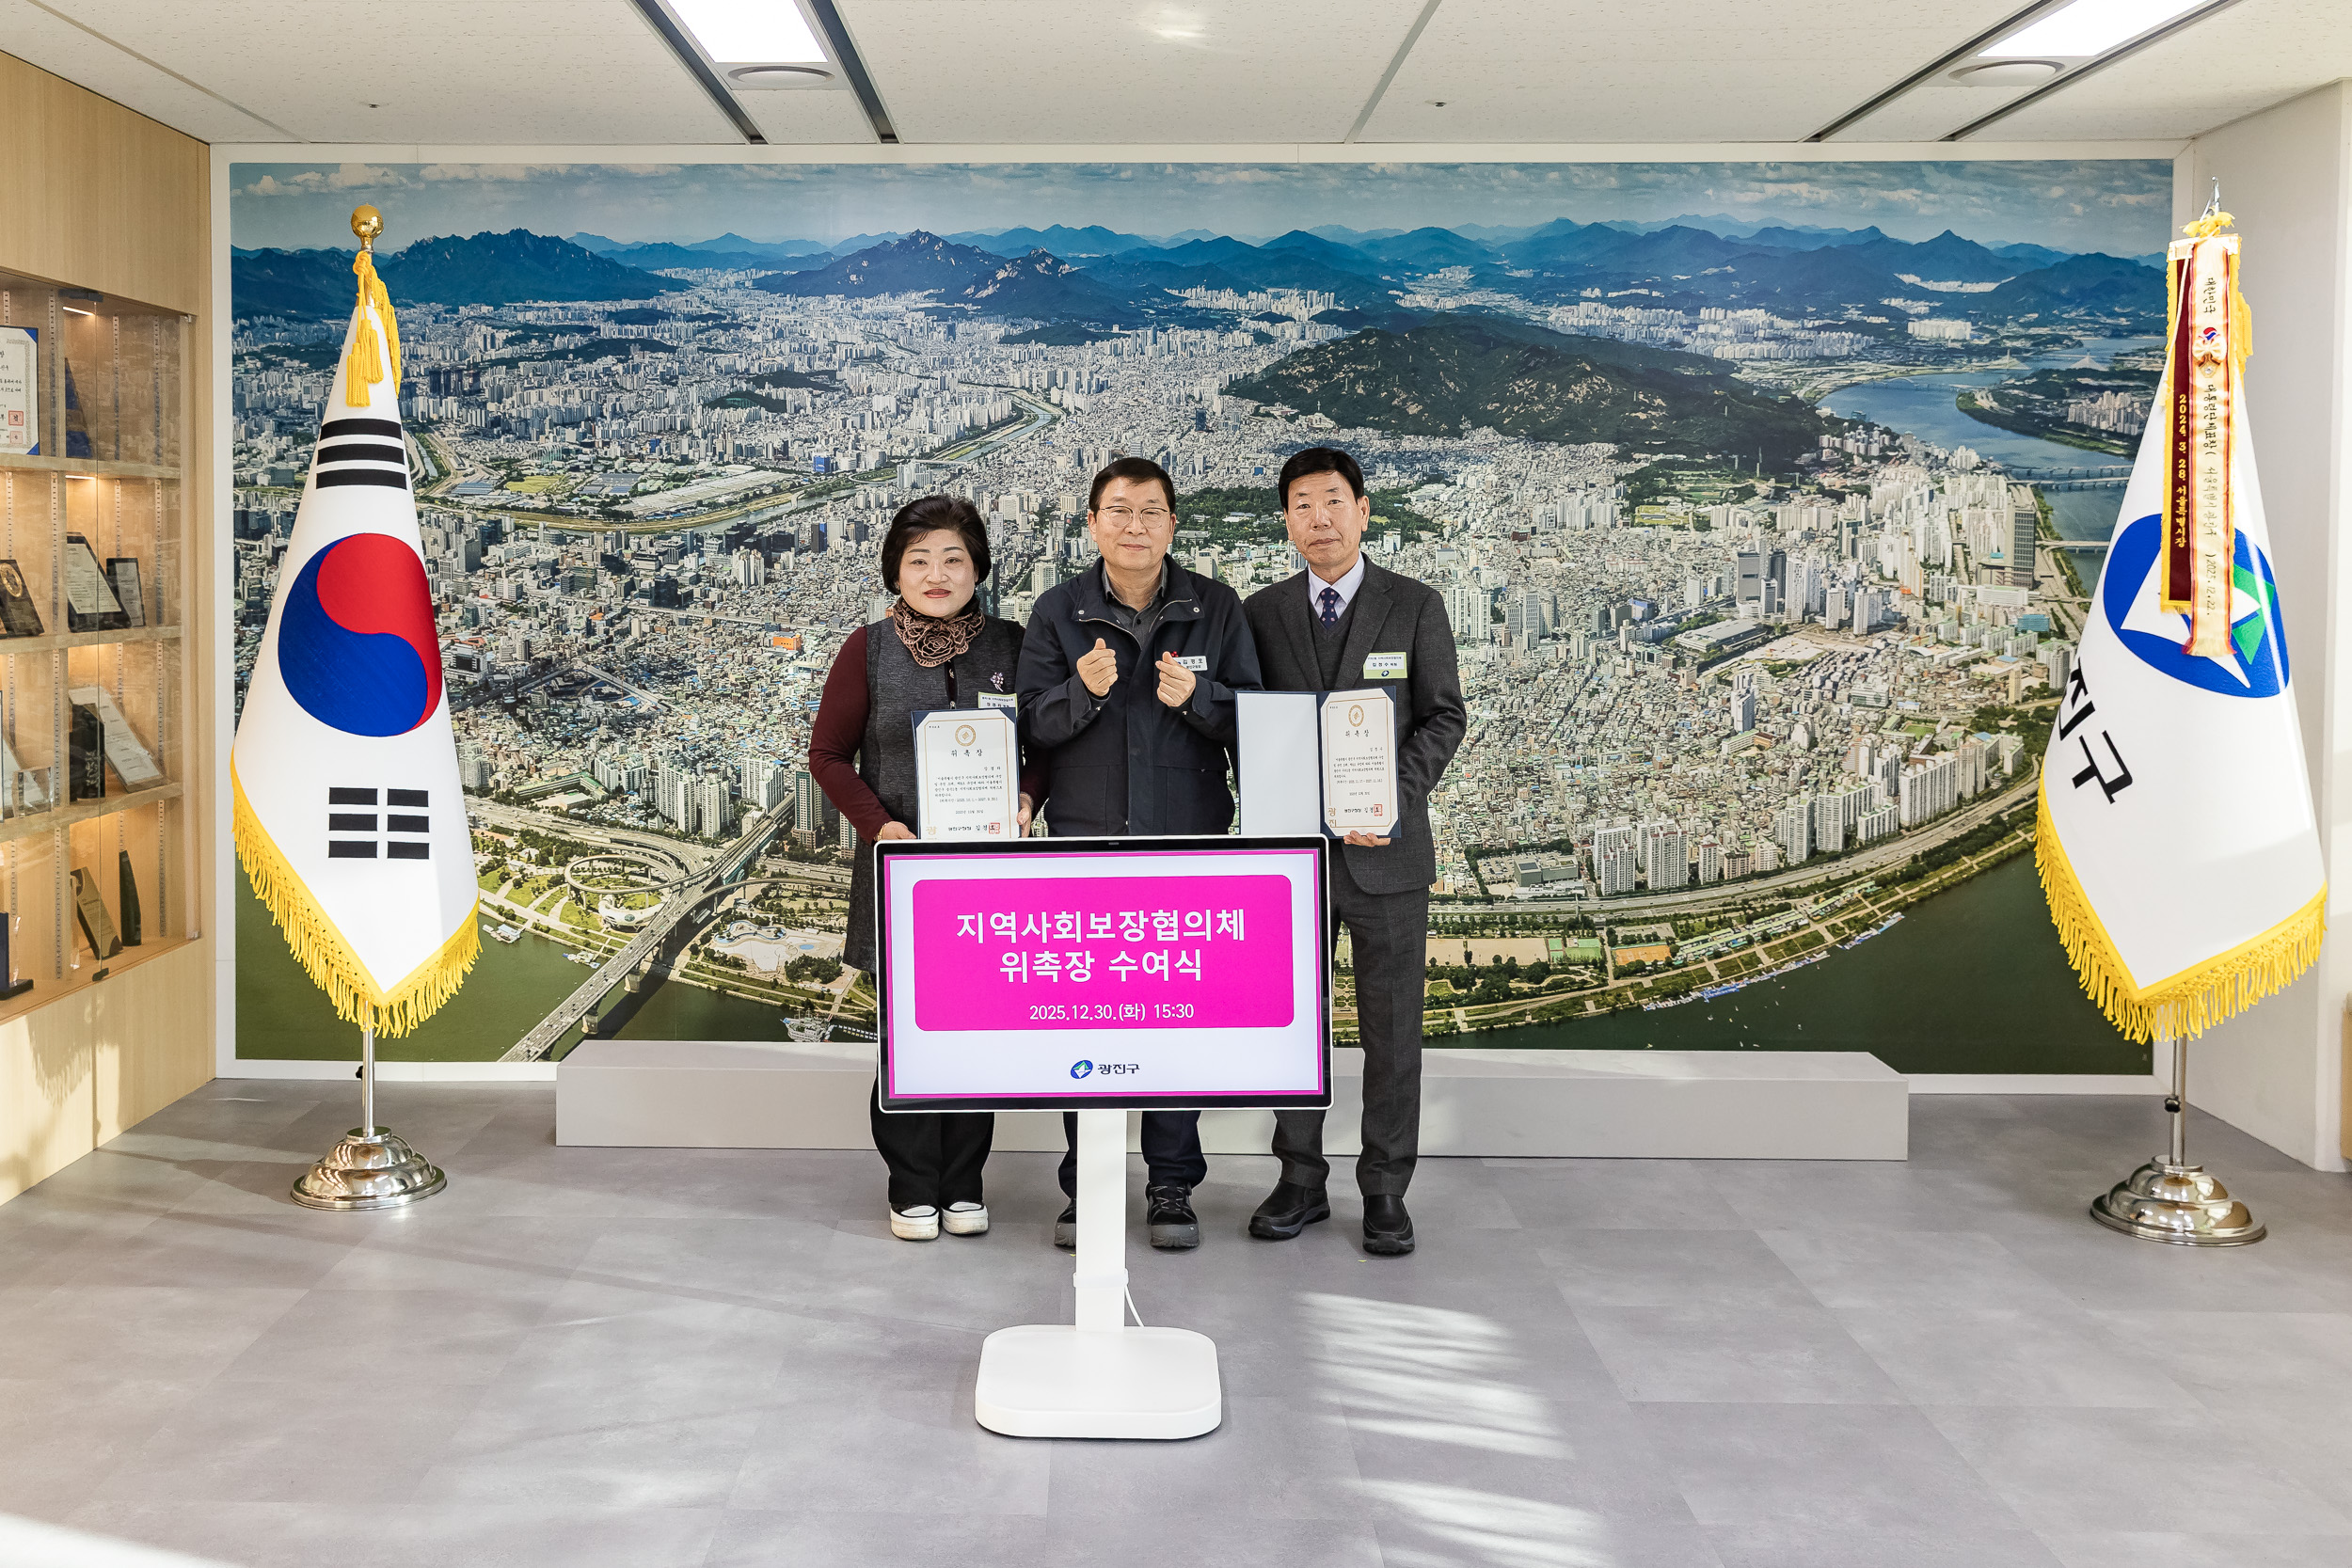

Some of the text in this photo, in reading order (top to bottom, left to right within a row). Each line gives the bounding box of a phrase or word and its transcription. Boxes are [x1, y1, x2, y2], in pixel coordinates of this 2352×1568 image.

[2202, 277, 2217, 314] 대한민국
[2202, 467, 2218, 508] 서울특별시
[2174, 484, 2188, 548] 서울특별시장
[2202, 511, 2217, 536] 광진구
[956, 909, 1245, 944] 지역사회보장협의체
[999, 948, 1201, 984] 위촉장 수여식
[1153, 1003, 1195, 1019] 15:30
[1097, 1063, 1140, 1075] 광진구
